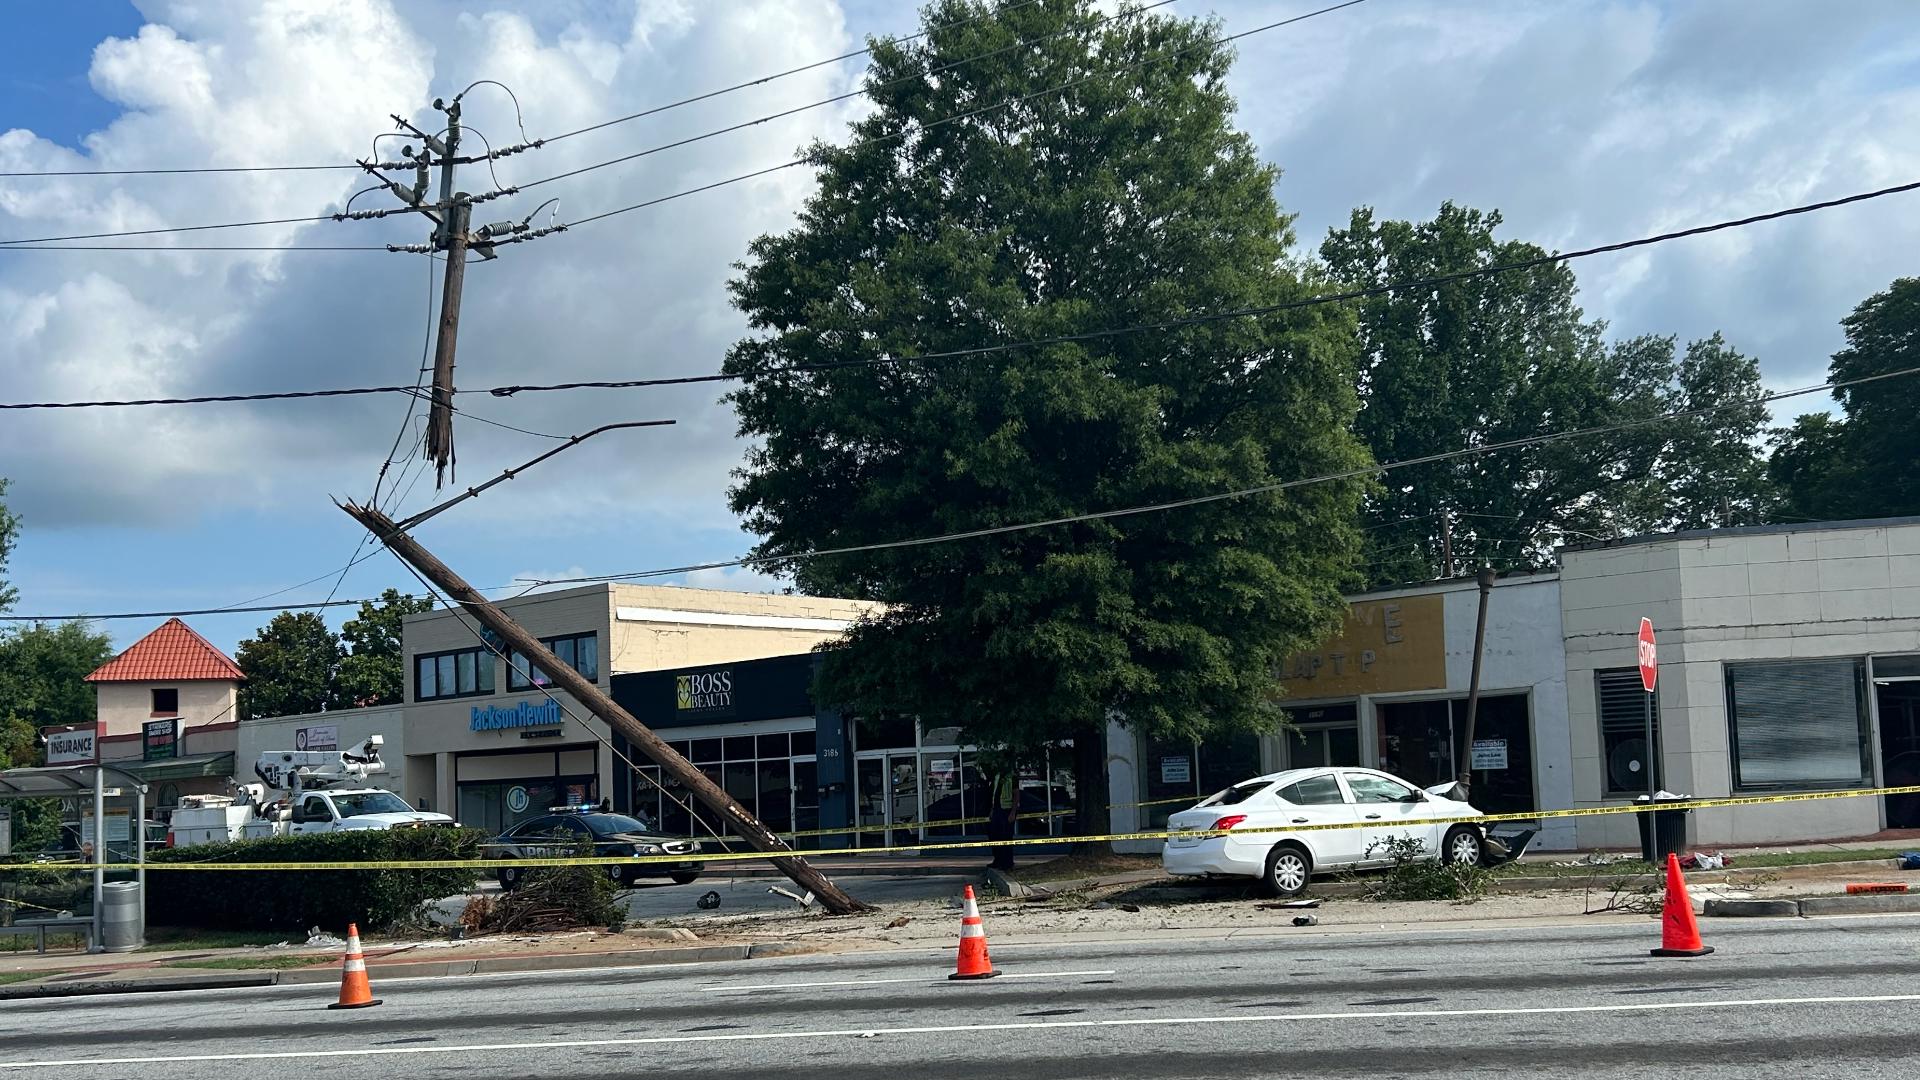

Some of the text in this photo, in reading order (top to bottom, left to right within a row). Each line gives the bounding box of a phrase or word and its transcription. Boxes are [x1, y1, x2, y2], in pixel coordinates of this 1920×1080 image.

[1640, 640, 1656, 669] STOP
[691, 671, 731, 695] BOSS
[691, 692, 731, 708] BEAUTY
[470, 698, 561, 732] Jackson Hewitt
[50, 738, 92, 755] INSURANCE
